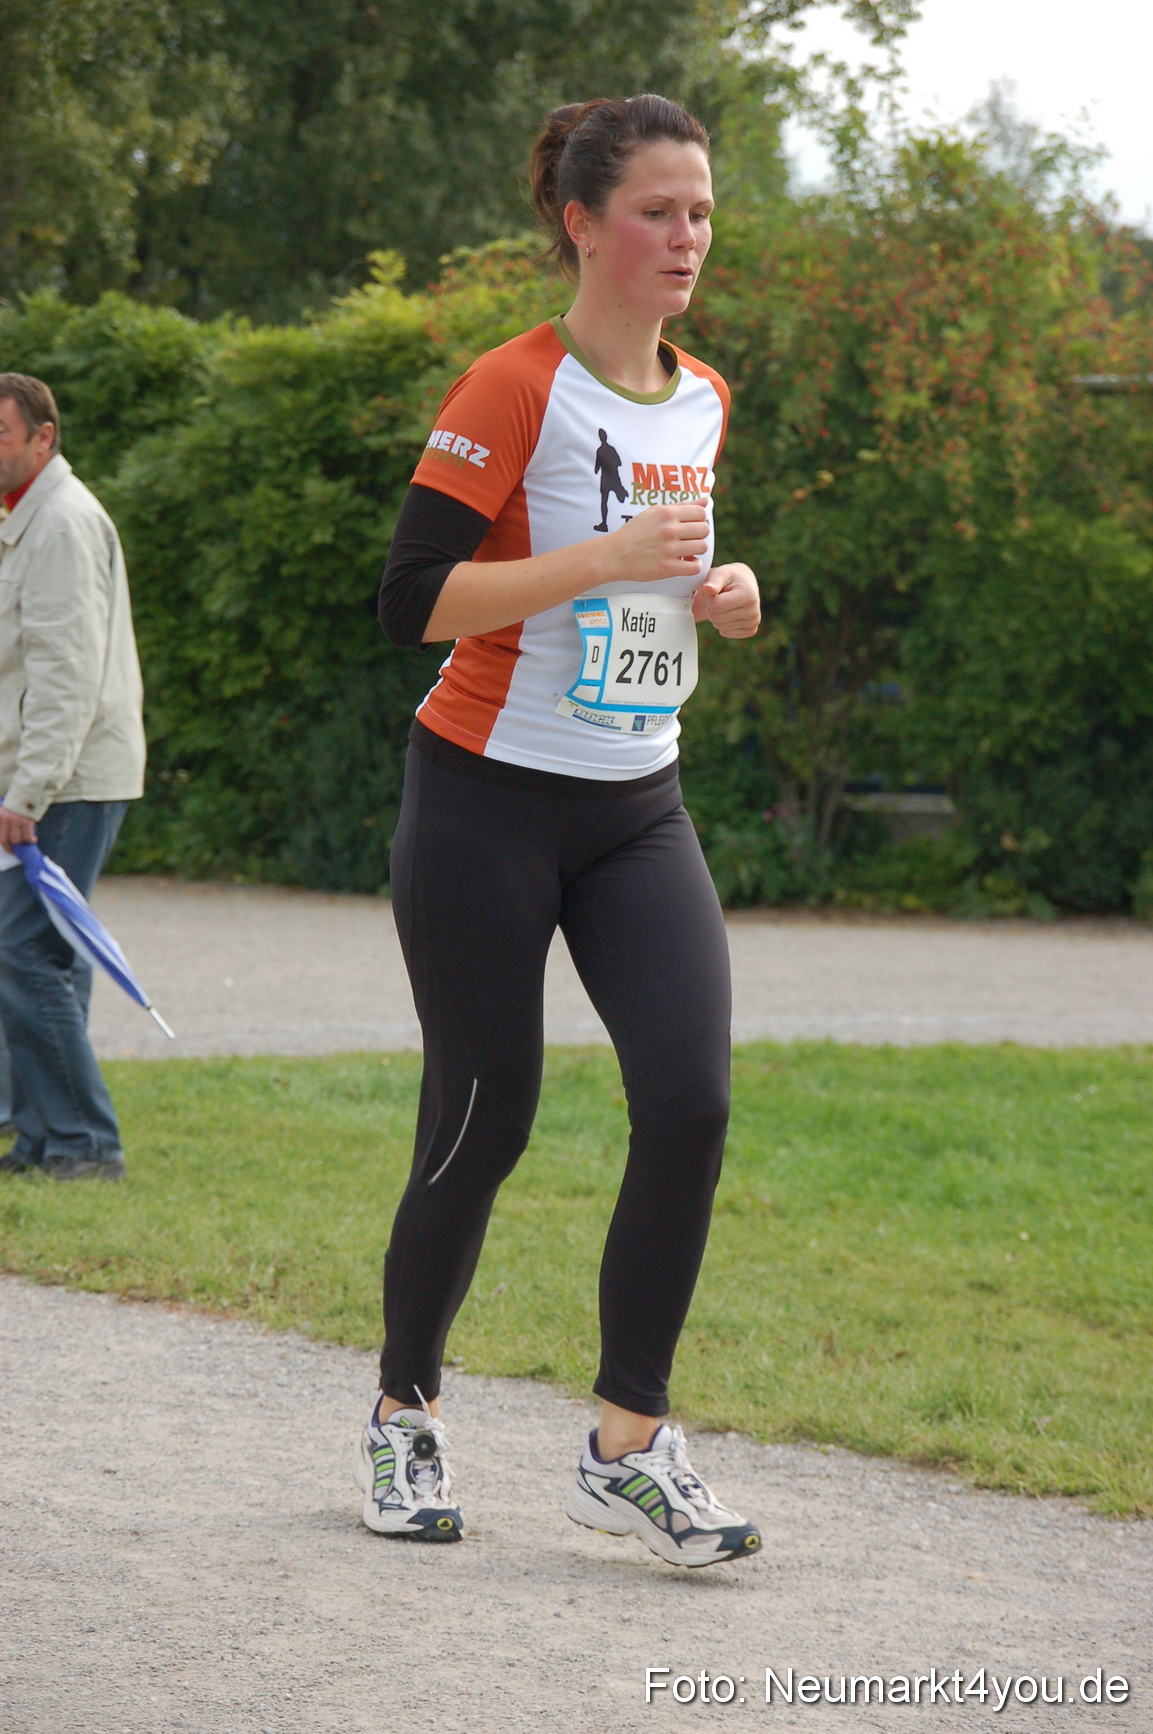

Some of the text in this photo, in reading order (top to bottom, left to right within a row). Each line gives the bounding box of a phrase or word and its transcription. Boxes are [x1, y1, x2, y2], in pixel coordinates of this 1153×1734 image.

[426, 430, 491, 469] MERZ
[632, 462, 711, 493] MERZ
[621, 607, 656, 638] Katja
[591, 645, 600, 663] D
[615, 649, 683, 687] 2761
